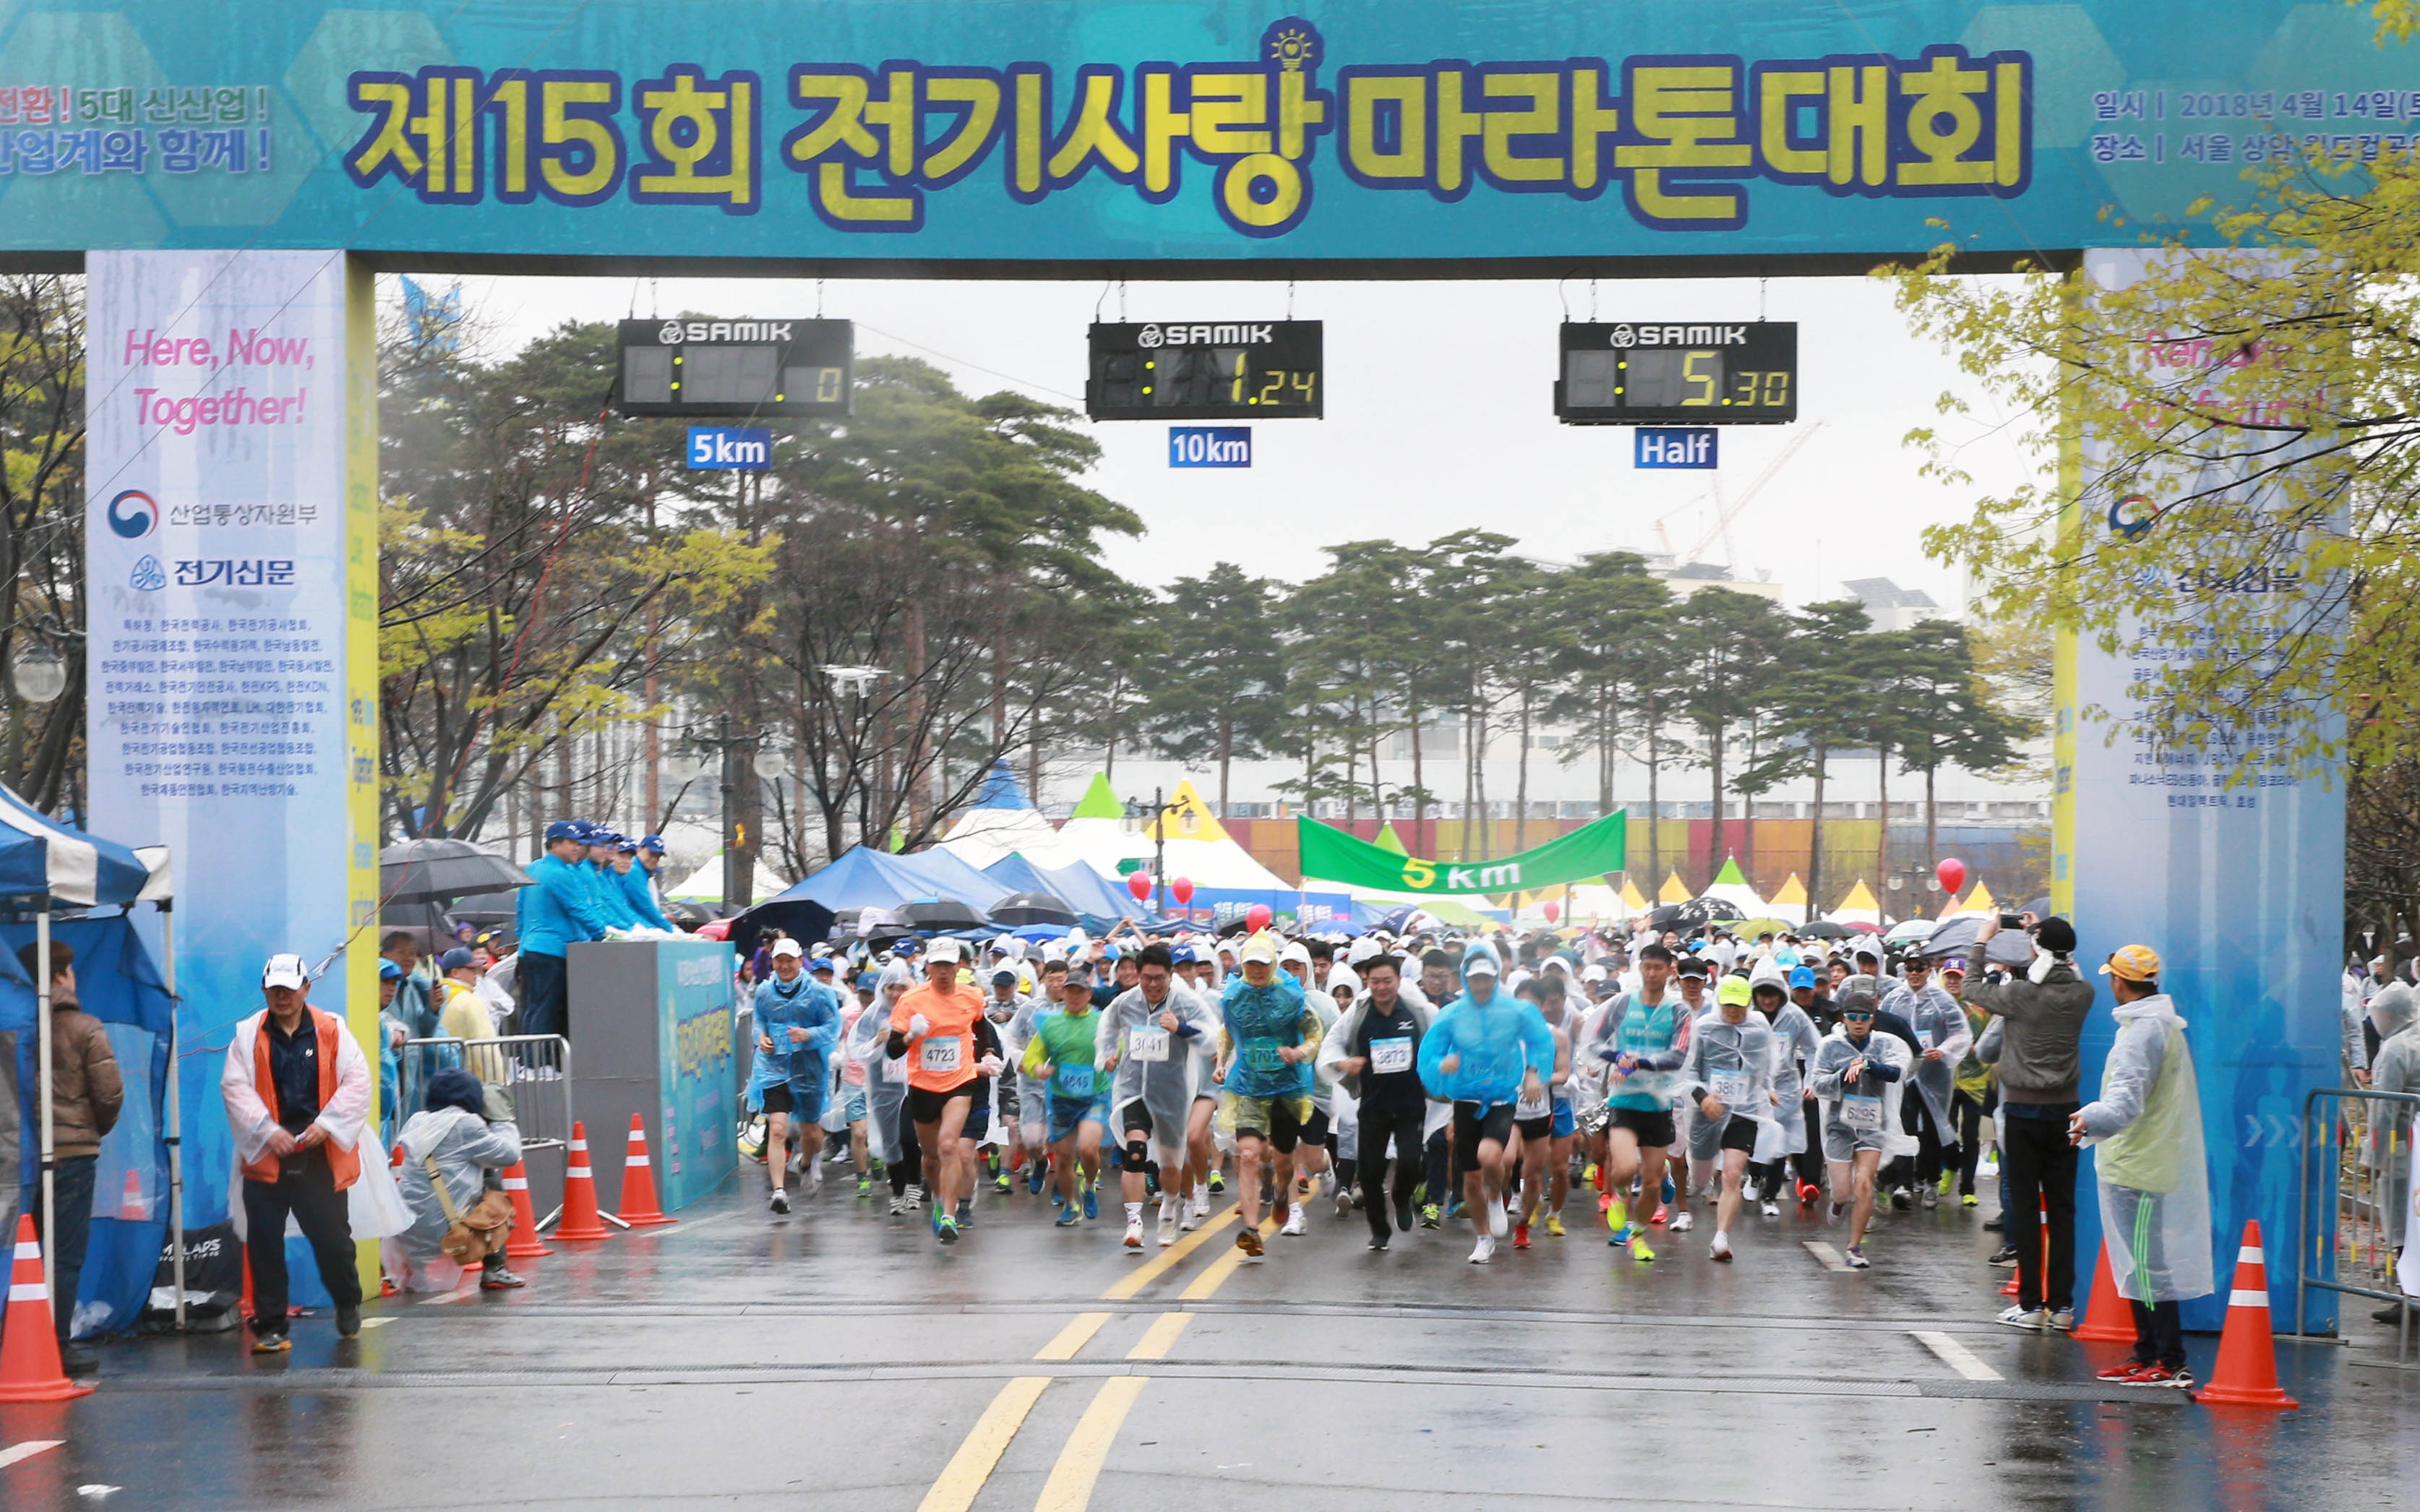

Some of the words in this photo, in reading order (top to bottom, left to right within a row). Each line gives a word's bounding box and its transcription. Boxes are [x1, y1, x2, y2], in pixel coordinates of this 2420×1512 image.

[79, 87, 135, 124] 5대
[2093, 91, 2145, 120] 일시
[2180, 91, 2274, 120] 2018년
[2281, 90, 2325, 119] 4월
[348, 66, 758, 215] 제15회
[789, 61, 1326, 230] 전기사랑
[1343, 56, 2027, 224] 마라톤대회
[2093, 134, 2146, 163] 장소
[2179, 134, 2233, 163] 서울
[687, 322, 793, 342] SAMIK
[1165, 325, 1274, 345] SAMIK
[1638, 325, 1747, 345] SAMIK
[124, 329, 218, 371] Here,
[226, 328, 315, 371] Now,
[133, 387, 307, 436] Together!
[694, 433, 766, 464] 5km
[1172, 432, 1249, 463] 10km
[1641, 433, 1712, 464] Half
[169, 503, 318, 526] 산업통상자원부
[173, 559, 296, 586] 전기신문
[926, 1048, 956, 1062] 4723
